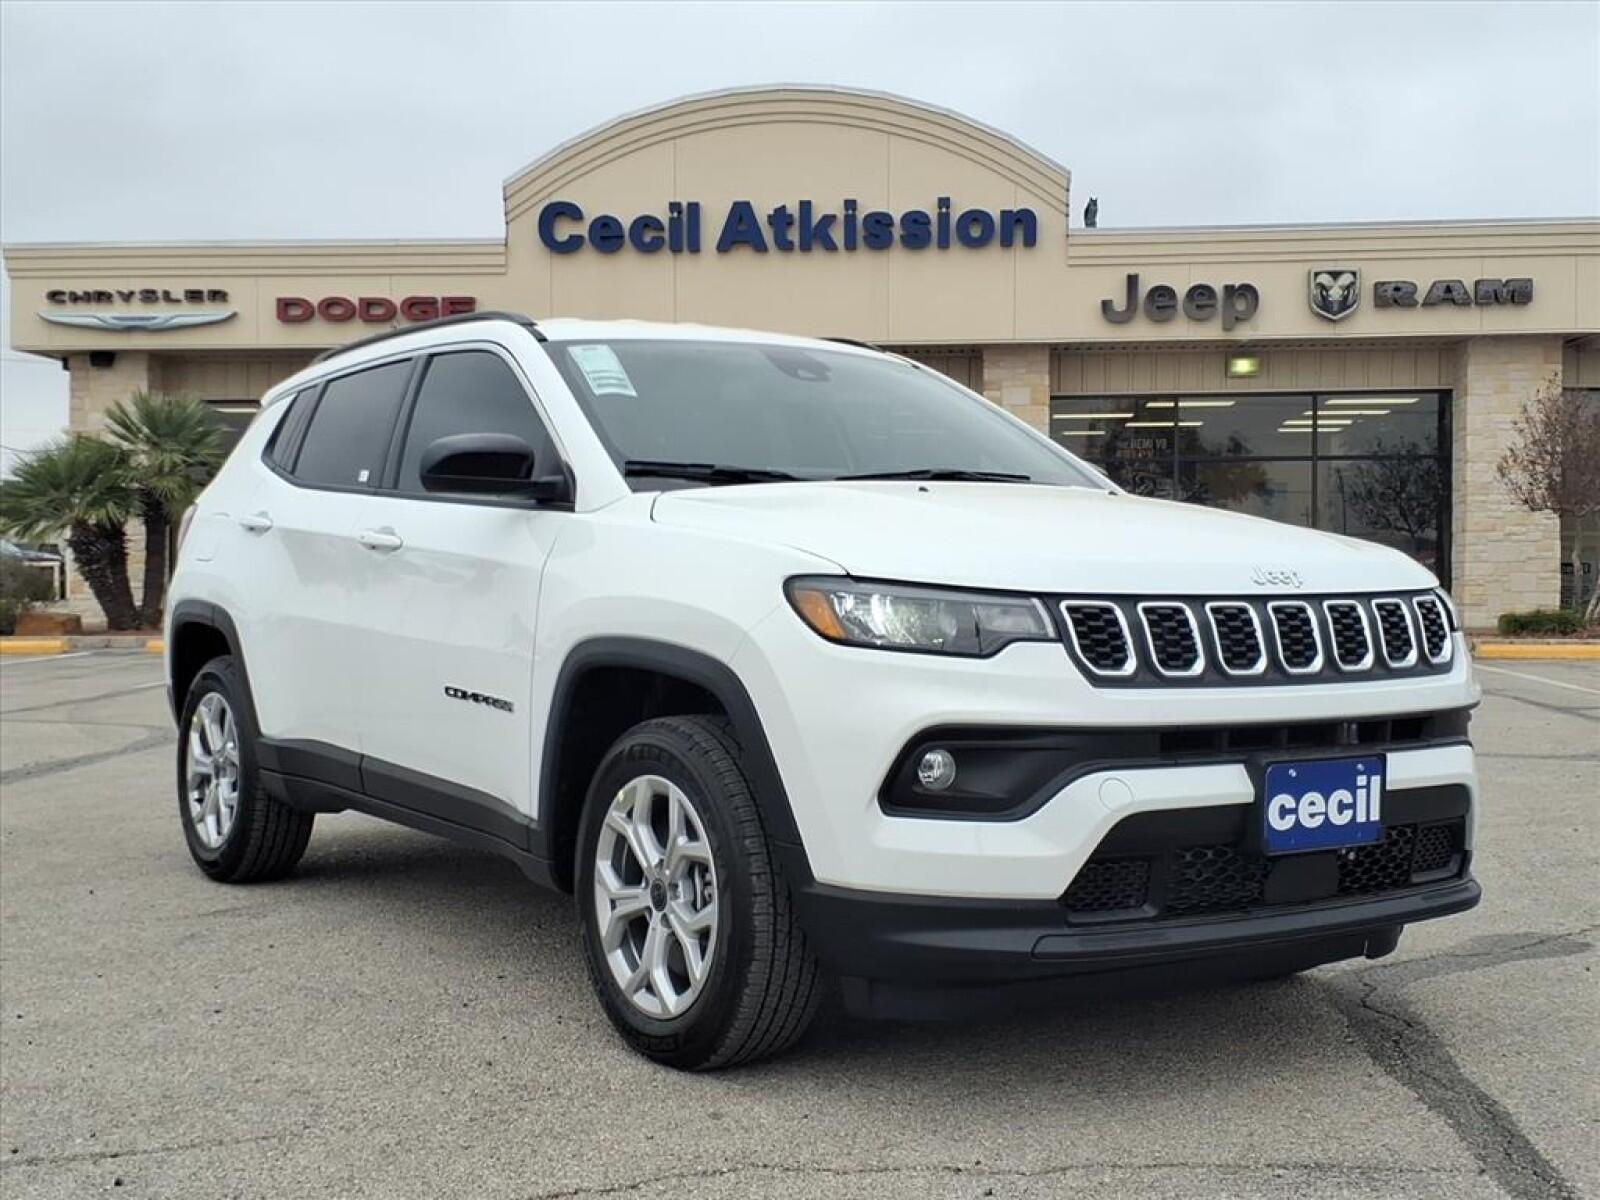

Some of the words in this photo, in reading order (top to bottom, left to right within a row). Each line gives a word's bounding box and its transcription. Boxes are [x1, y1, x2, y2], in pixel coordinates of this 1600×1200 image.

[538, 200, 700, 254] Cecil
[716, 197, 1037, 252] Atkission
[46, 289, 228, 304] CHRYSLER
[1101, 273, 1259, 331] Jeep
[1374, 278, 1533, 308] RAM
[276, 297, 476, 323] DODGE
[1250, 563, 1303, 588] Jeep
[444, 685, 514, 713] COMPASS
[1268, 774, 1381, 831] cecil
